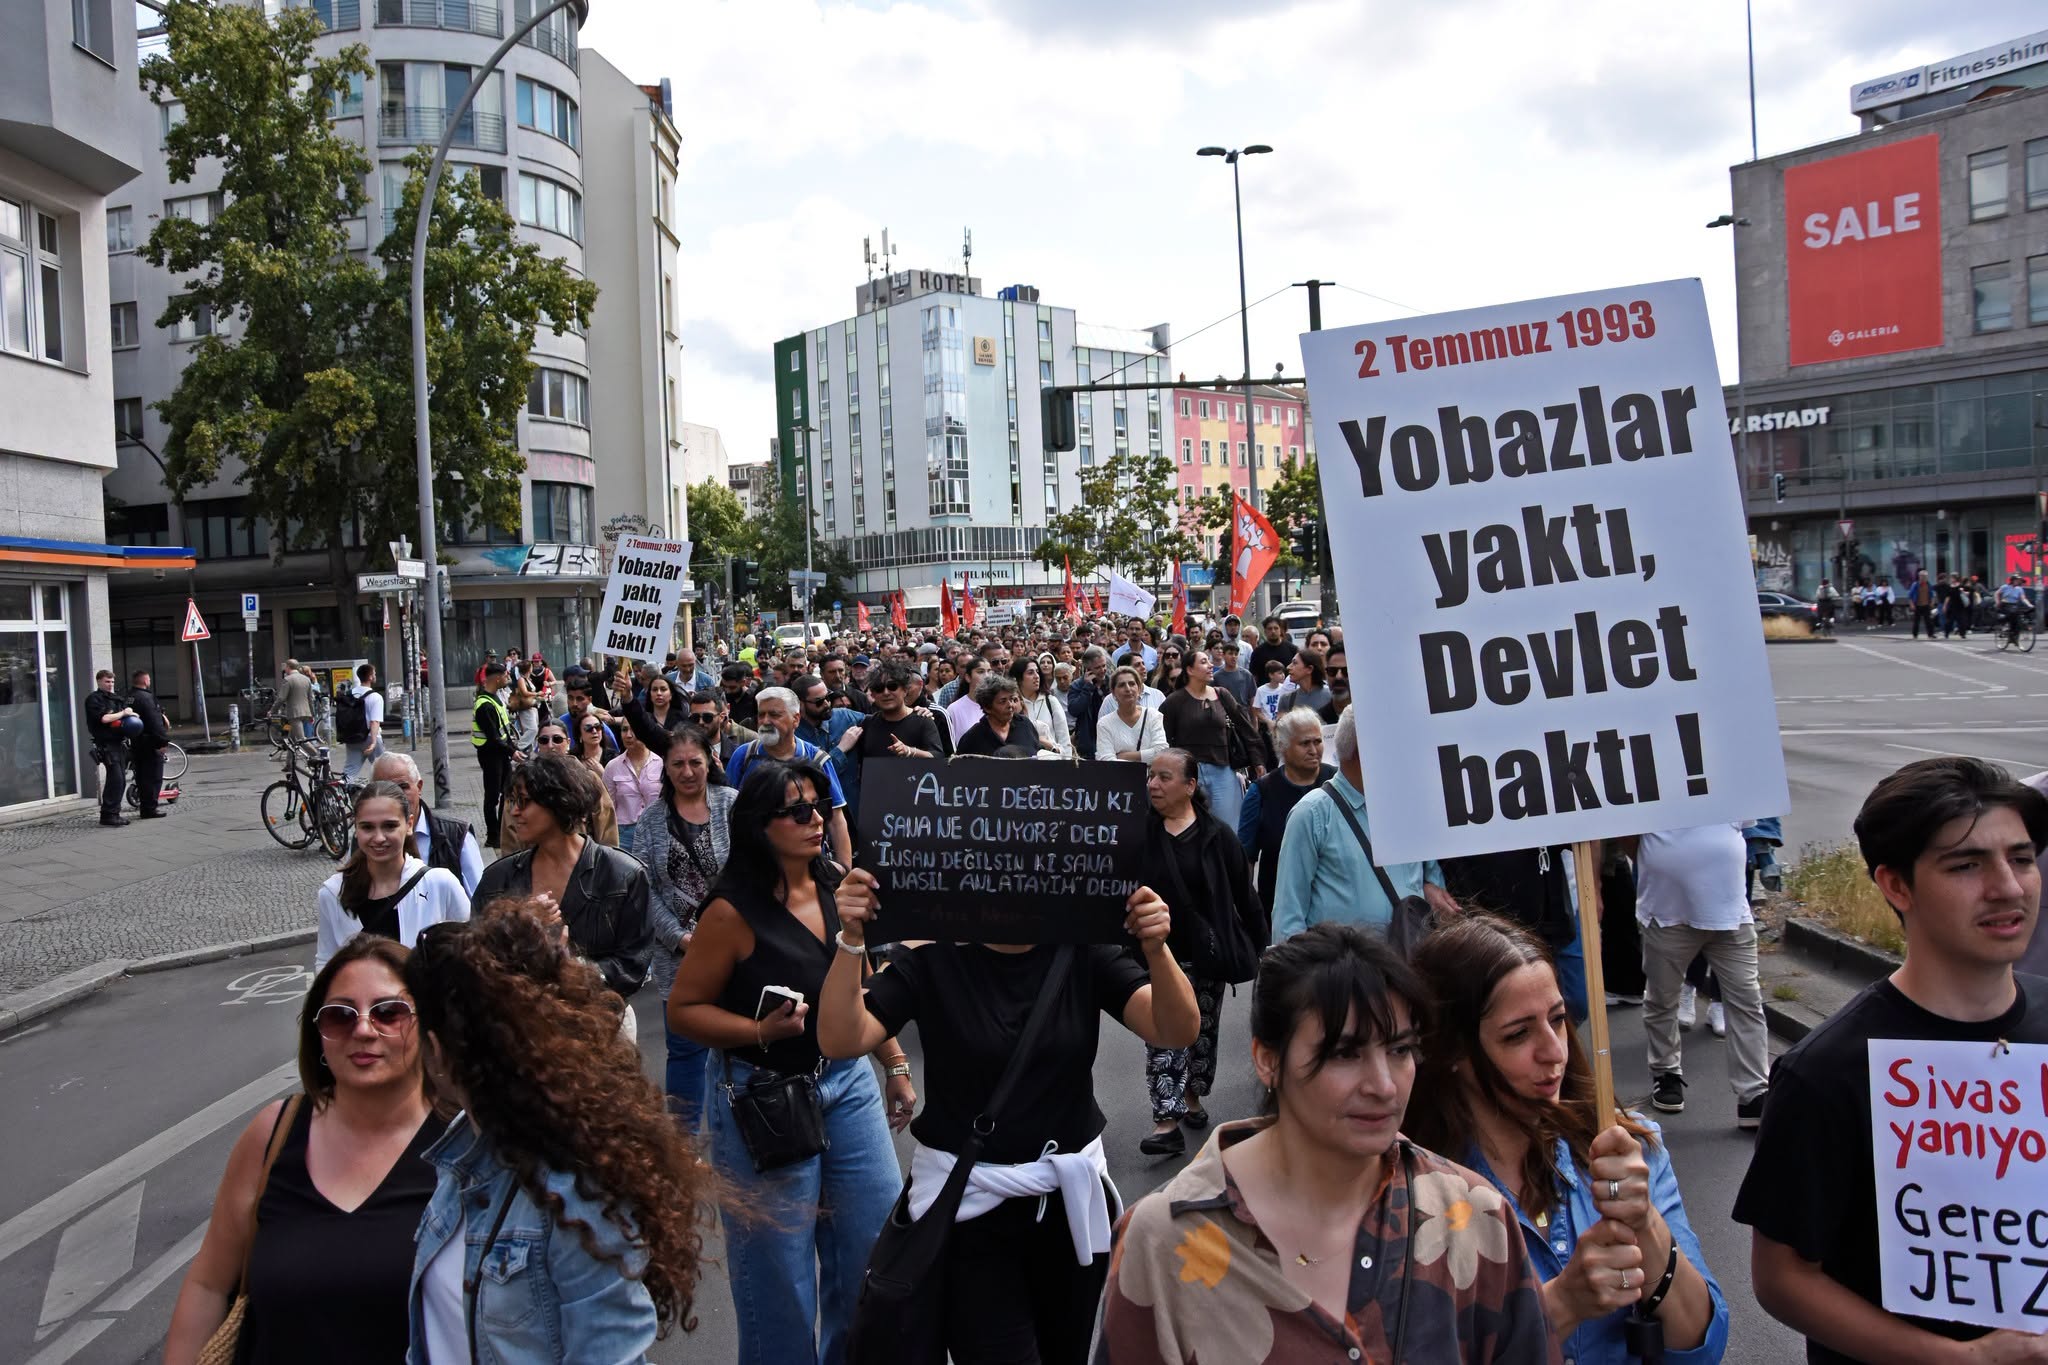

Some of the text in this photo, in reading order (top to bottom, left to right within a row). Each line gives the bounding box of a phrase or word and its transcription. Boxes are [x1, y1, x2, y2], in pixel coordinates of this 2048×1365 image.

[1803, 192, 1920, 249] SALE
[920, 271, 976, 296] HOTEL
[1353, 300, 1657, 378] 2 Temmuz 1993
[1846, 324, 1900, 342] GALERIA
[1728, 406, 1830, 435] ARSTADT
[1338, 385, 1698, 498] Yobazlar
[626, 538, 682, 553] 2 Temmuz 1993
[1421, 503, 1656, 609] yaktı,
[618, 555, 682, 580] Yobazlar
[981, 570, 1010, 579] HOSTEL
[621, 583, 662, 606] yaktı,
[612, 605, 662, 629] Devlet
[606, 629, 656, 654] baktı !
[1419, 605, 1697, 714] Devlet
[1437, 712, 1709, 828] baktı !
[882, 813, 931, 839] SANA
[937, 816, 962, 840] NE
[1070, 824, 1119, 845] DEDI
[1062, 854, 1114, 874] SANA
[892, 871, 949, 892] NASIL
[1884, 1057, 2022, 1115] Sivas
[1895, 1183, 2048, 1248] Gerec
[1908, 1246, 2048, 1317] JETZ
